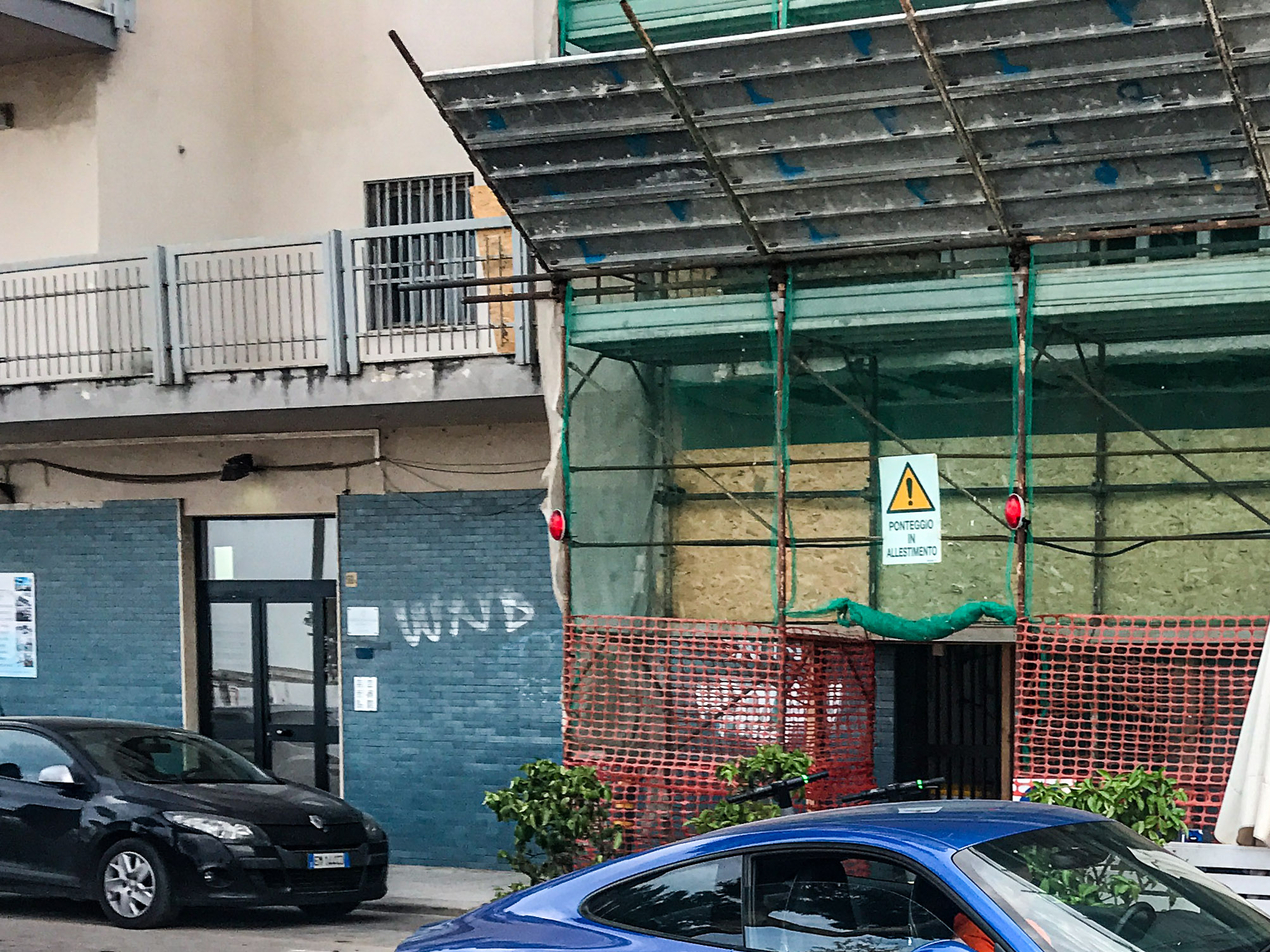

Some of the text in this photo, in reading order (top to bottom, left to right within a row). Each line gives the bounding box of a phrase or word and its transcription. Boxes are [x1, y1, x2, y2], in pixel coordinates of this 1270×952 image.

[889, 519, 934, 531] PONTEGGIO
[908, 534, 916, 543] IN
[887, 546, 937, 557] ALLESTIMENTO
